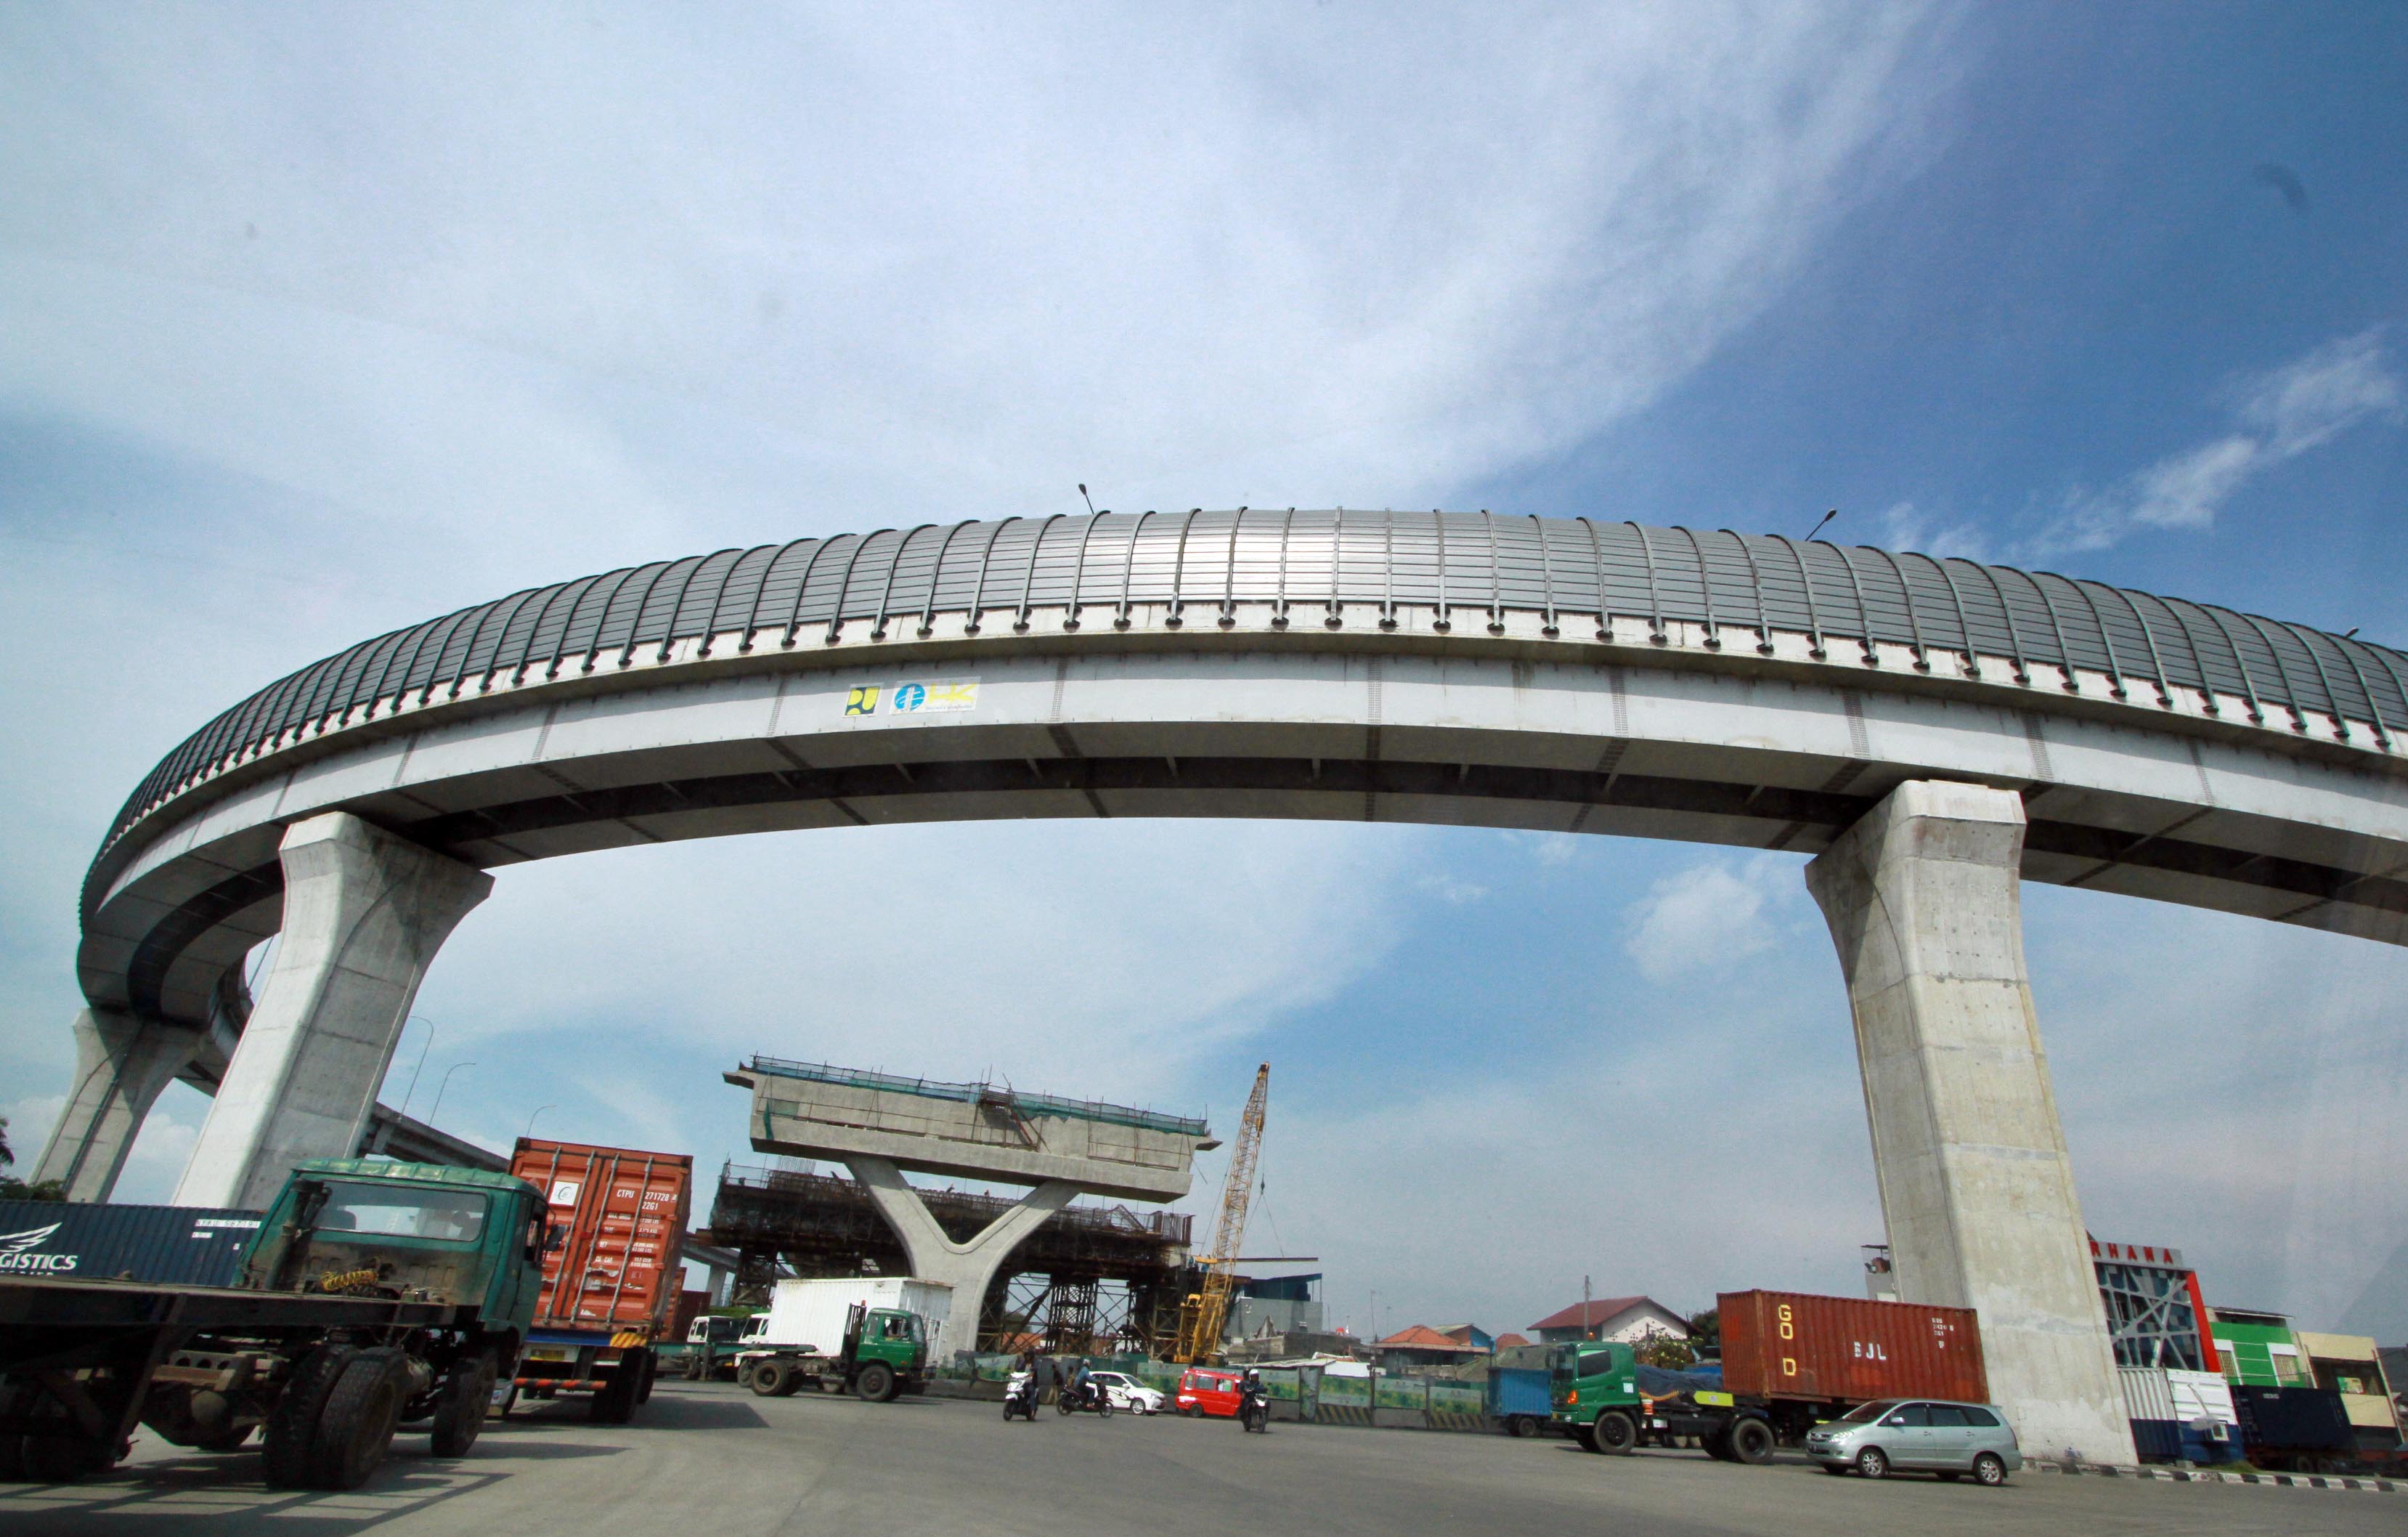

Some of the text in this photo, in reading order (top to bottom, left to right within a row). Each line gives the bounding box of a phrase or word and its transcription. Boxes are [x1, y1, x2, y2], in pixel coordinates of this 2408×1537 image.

[617, 1189, 635, 1199] CTPU
[644, 1191, 670, 1201] 271728
[642, 1201, 659, 1210] 22G1
